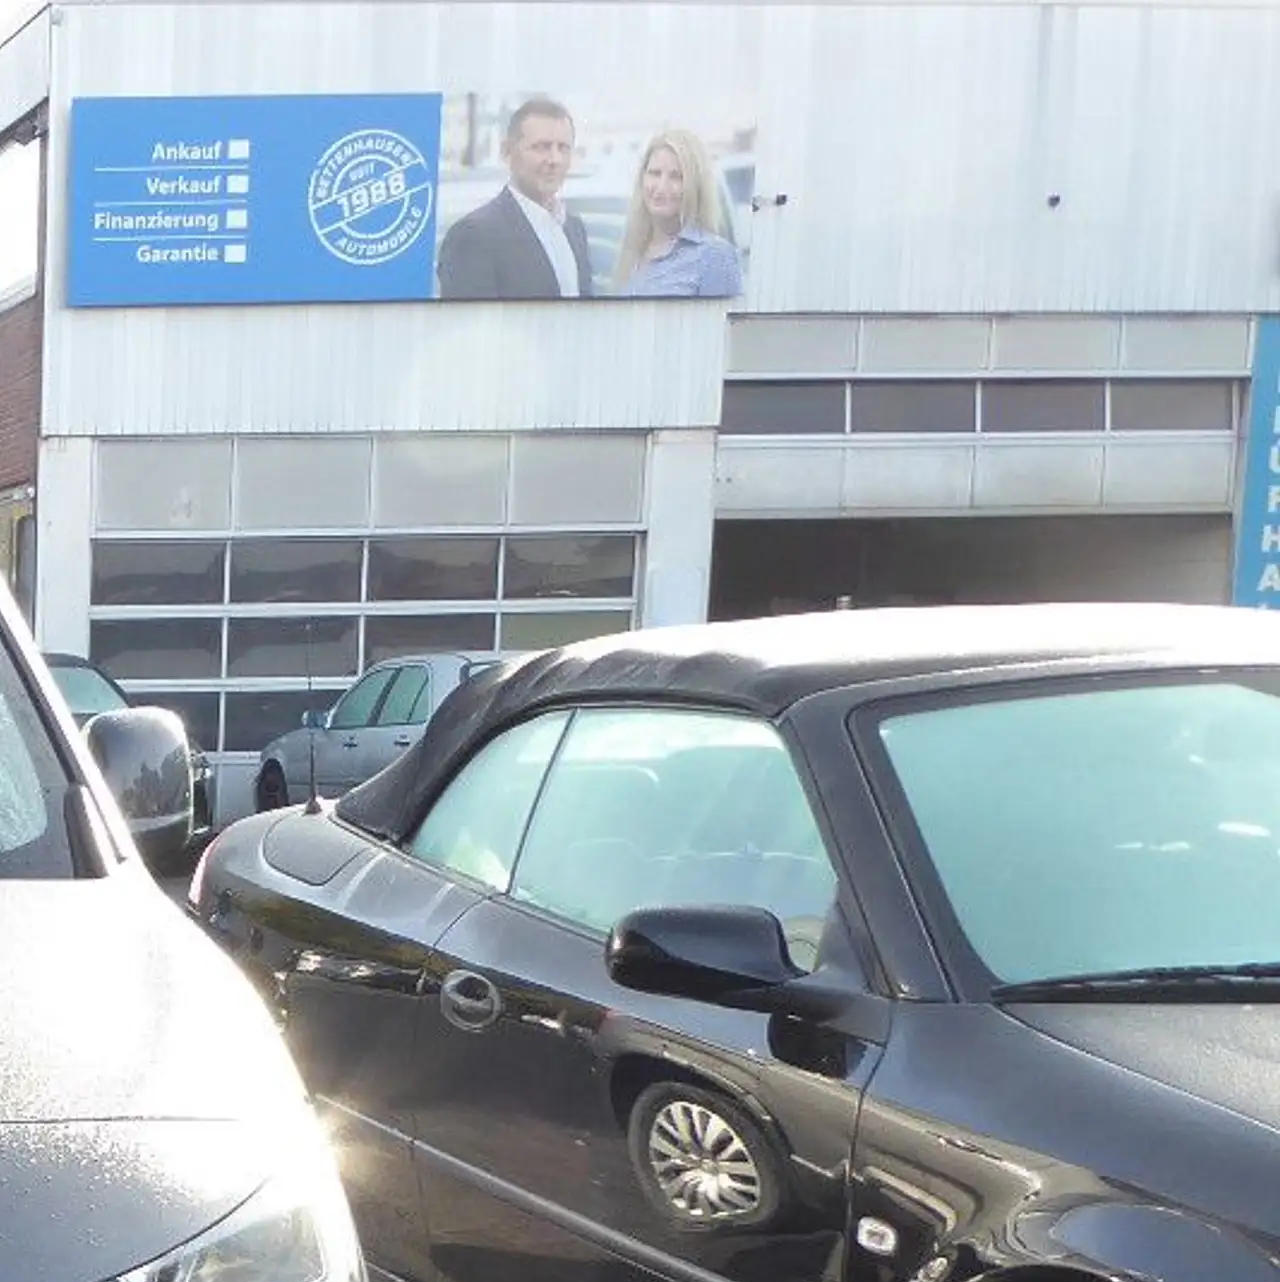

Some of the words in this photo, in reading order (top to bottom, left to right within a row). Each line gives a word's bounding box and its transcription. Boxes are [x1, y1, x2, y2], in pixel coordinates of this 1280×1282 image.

[151, 140, 222, 162] Ankauf
[146, 175, 221, 195] Verkauf
[93, 210, 219, 232] Finanzierung
[136, 243, 219, 263] Garantie
